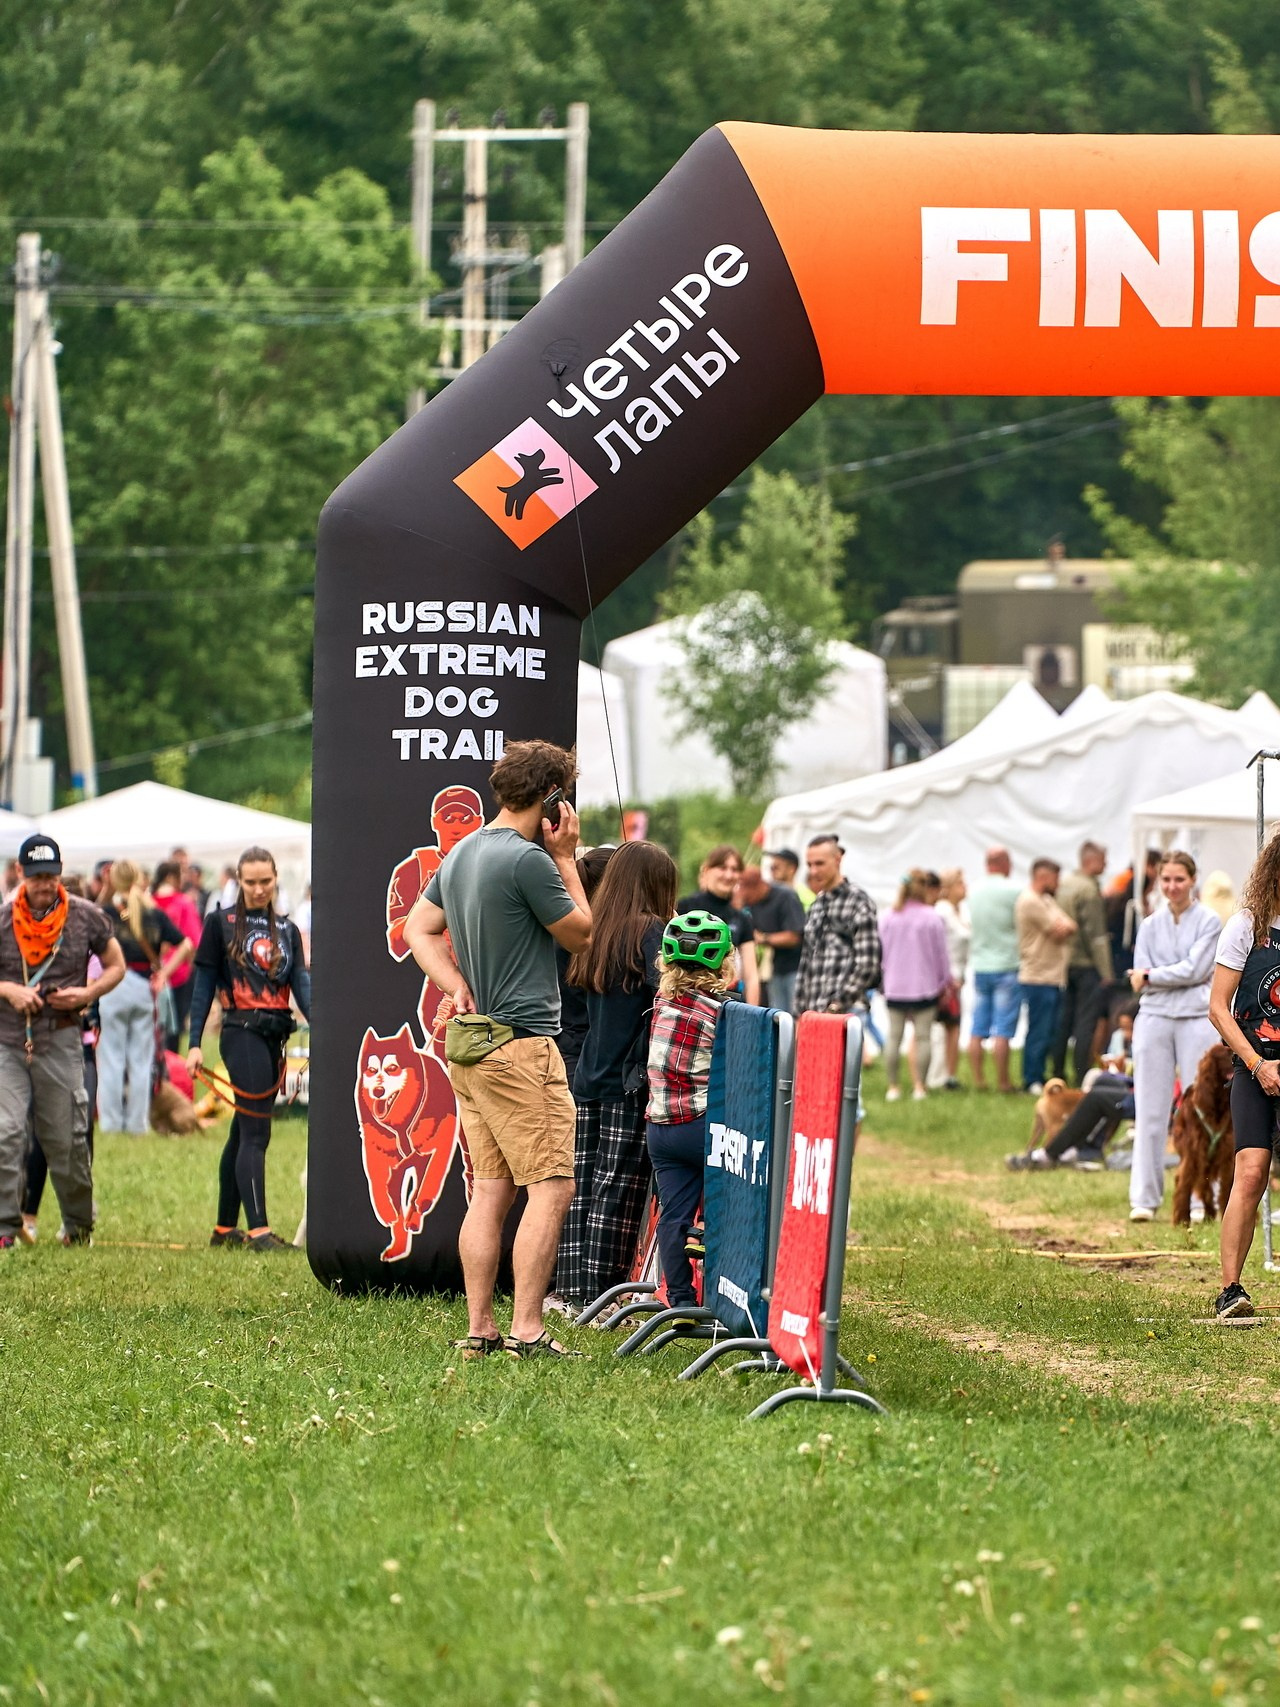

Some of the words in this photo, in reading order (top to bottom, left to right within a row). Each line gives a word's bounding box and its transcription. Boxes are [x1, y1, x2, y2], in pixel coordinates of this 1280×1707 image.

[547, 243, 750, 418] четыре
[593, 328, 741, 474] лапы
[362, 600, 541, 638] RUSSIAN
[355, 643, 546, 681] EXTREME
[404, 686, 499, 718] DOG
